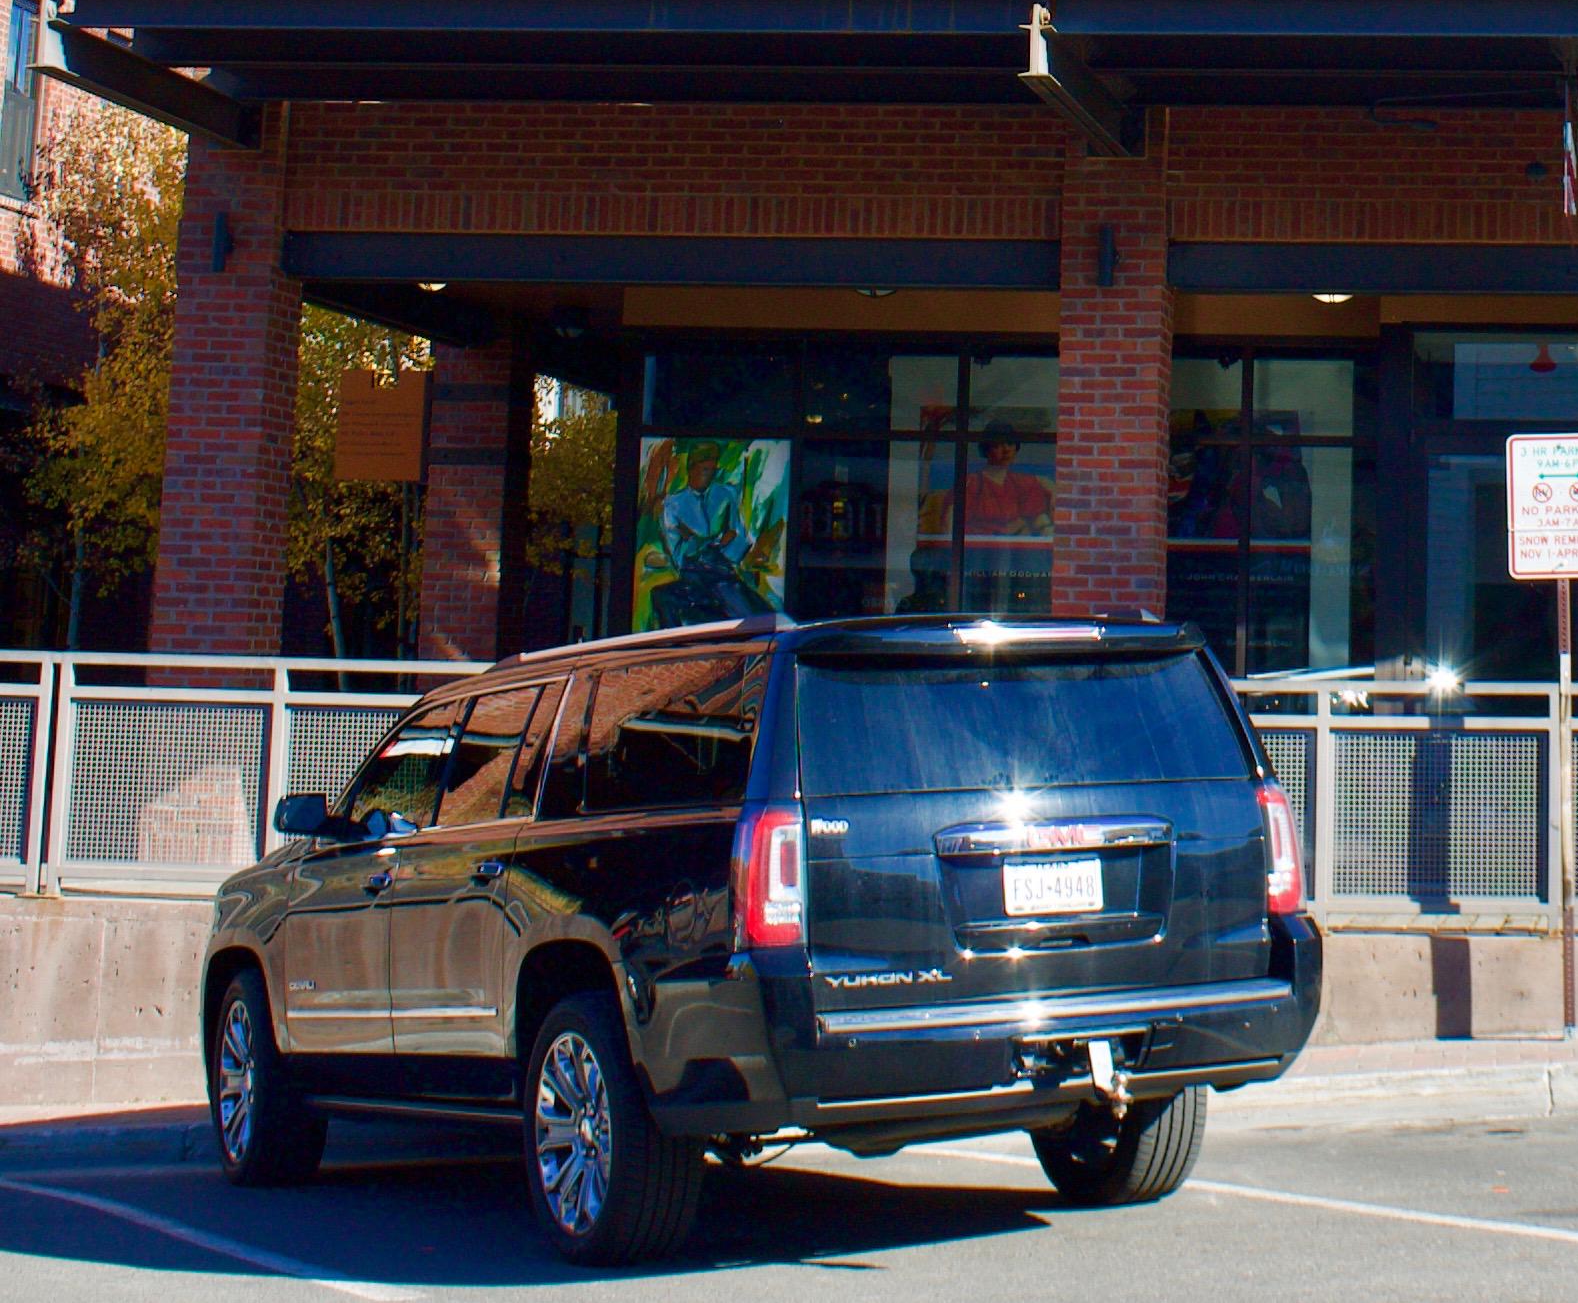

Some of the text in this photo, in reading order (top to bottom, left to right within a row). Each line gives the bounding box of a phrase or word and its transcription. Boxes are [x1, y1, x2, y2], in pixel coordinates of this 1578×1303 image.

[1533, 446, 1547, 456] HR
[1521, 506, 1539, 516] NO
[1519, 536, 1549, 546] SNOW
[1520, 549, 1541, 559] NOV
[824, 968, 952, 989] YUKON XL
